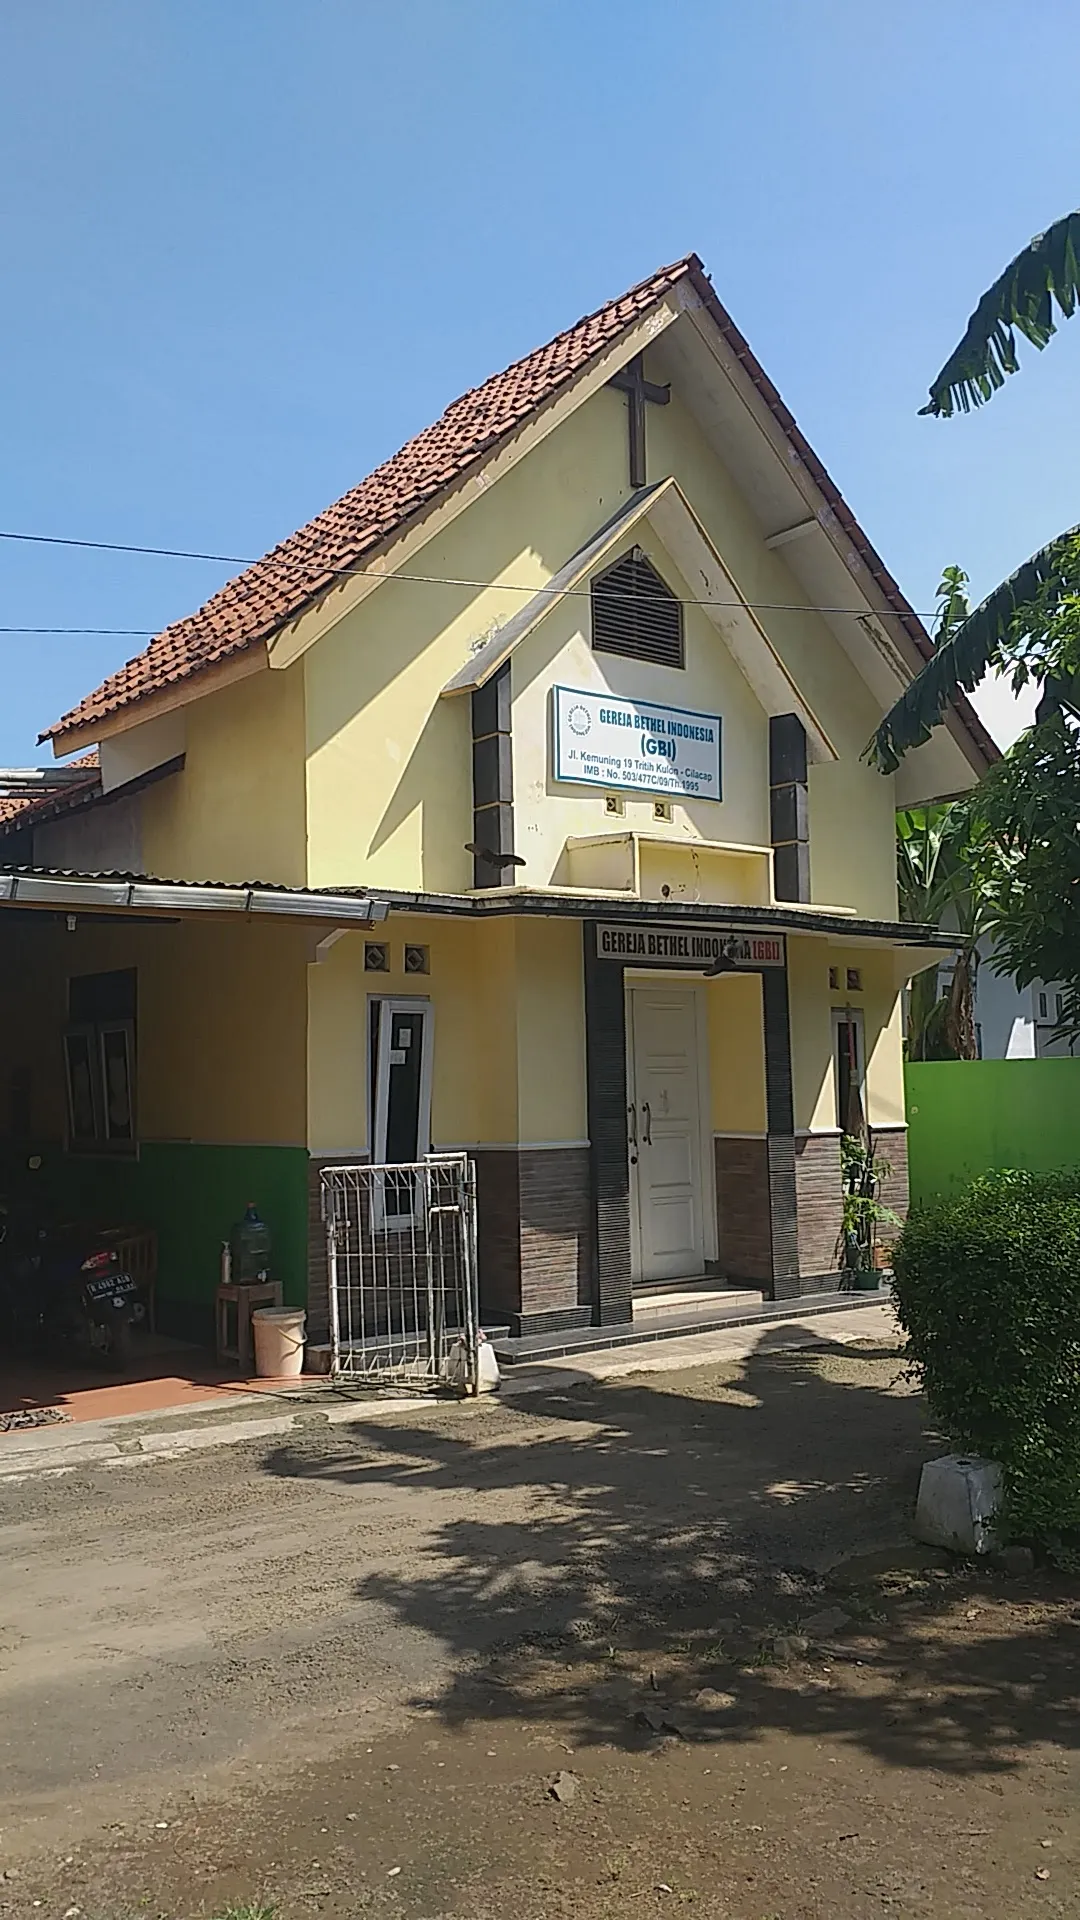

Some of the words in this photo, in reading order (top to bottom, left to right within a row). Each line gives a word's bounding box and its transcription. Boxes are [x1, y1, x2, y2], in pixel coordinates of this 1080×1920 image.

[600, 708, 633, 728] GEREJA
[634, 714, 666, 734] BETHEL
[667, 720, 714, 743] INDONESIA
[641, 733, 676, 762] (GBI)
[568, 749, 578, 760] Jl.
[580, 751, 621, 769] Kemuning
[624, 758, 633, 768] 19
[634, 759, 654, 772] Tritih
[656, 763, 679, 775] Kulon
[684, 768, 713, 783] Cilacap
[583, 764, 600, 776] IMB
[606, 768, 621, 780] No.
[602, 930, 646, 954] GEREJA
[647, 934, 689, 957] BETHEL
